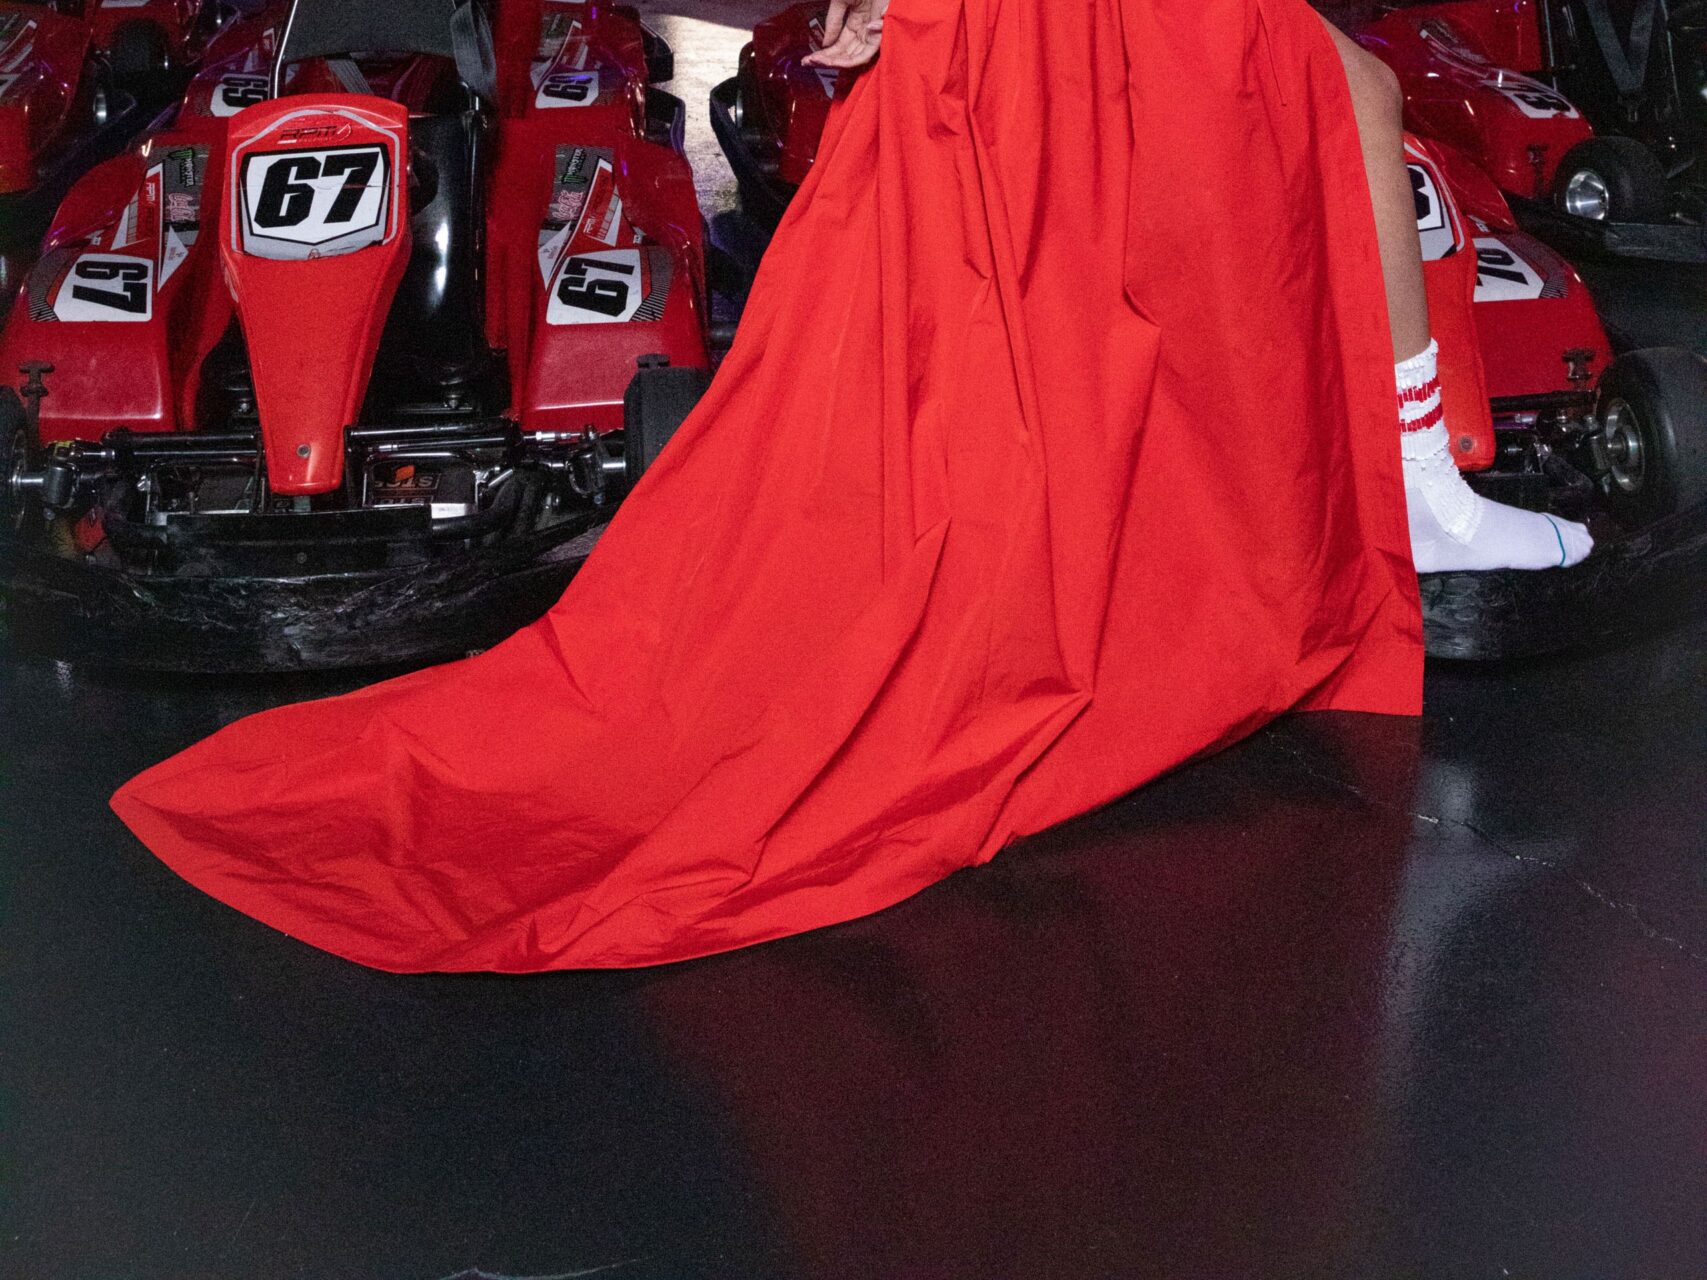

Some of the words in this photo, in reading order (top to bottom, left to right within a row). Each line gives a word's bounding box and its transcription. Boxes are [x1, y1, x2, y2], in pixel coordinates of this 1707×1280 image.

[222, 77, 269, 108] 69
[254, 151, 380, 228] 67
[72, 260, 149, 314] 67
[557, 257, 635, 317] 67
